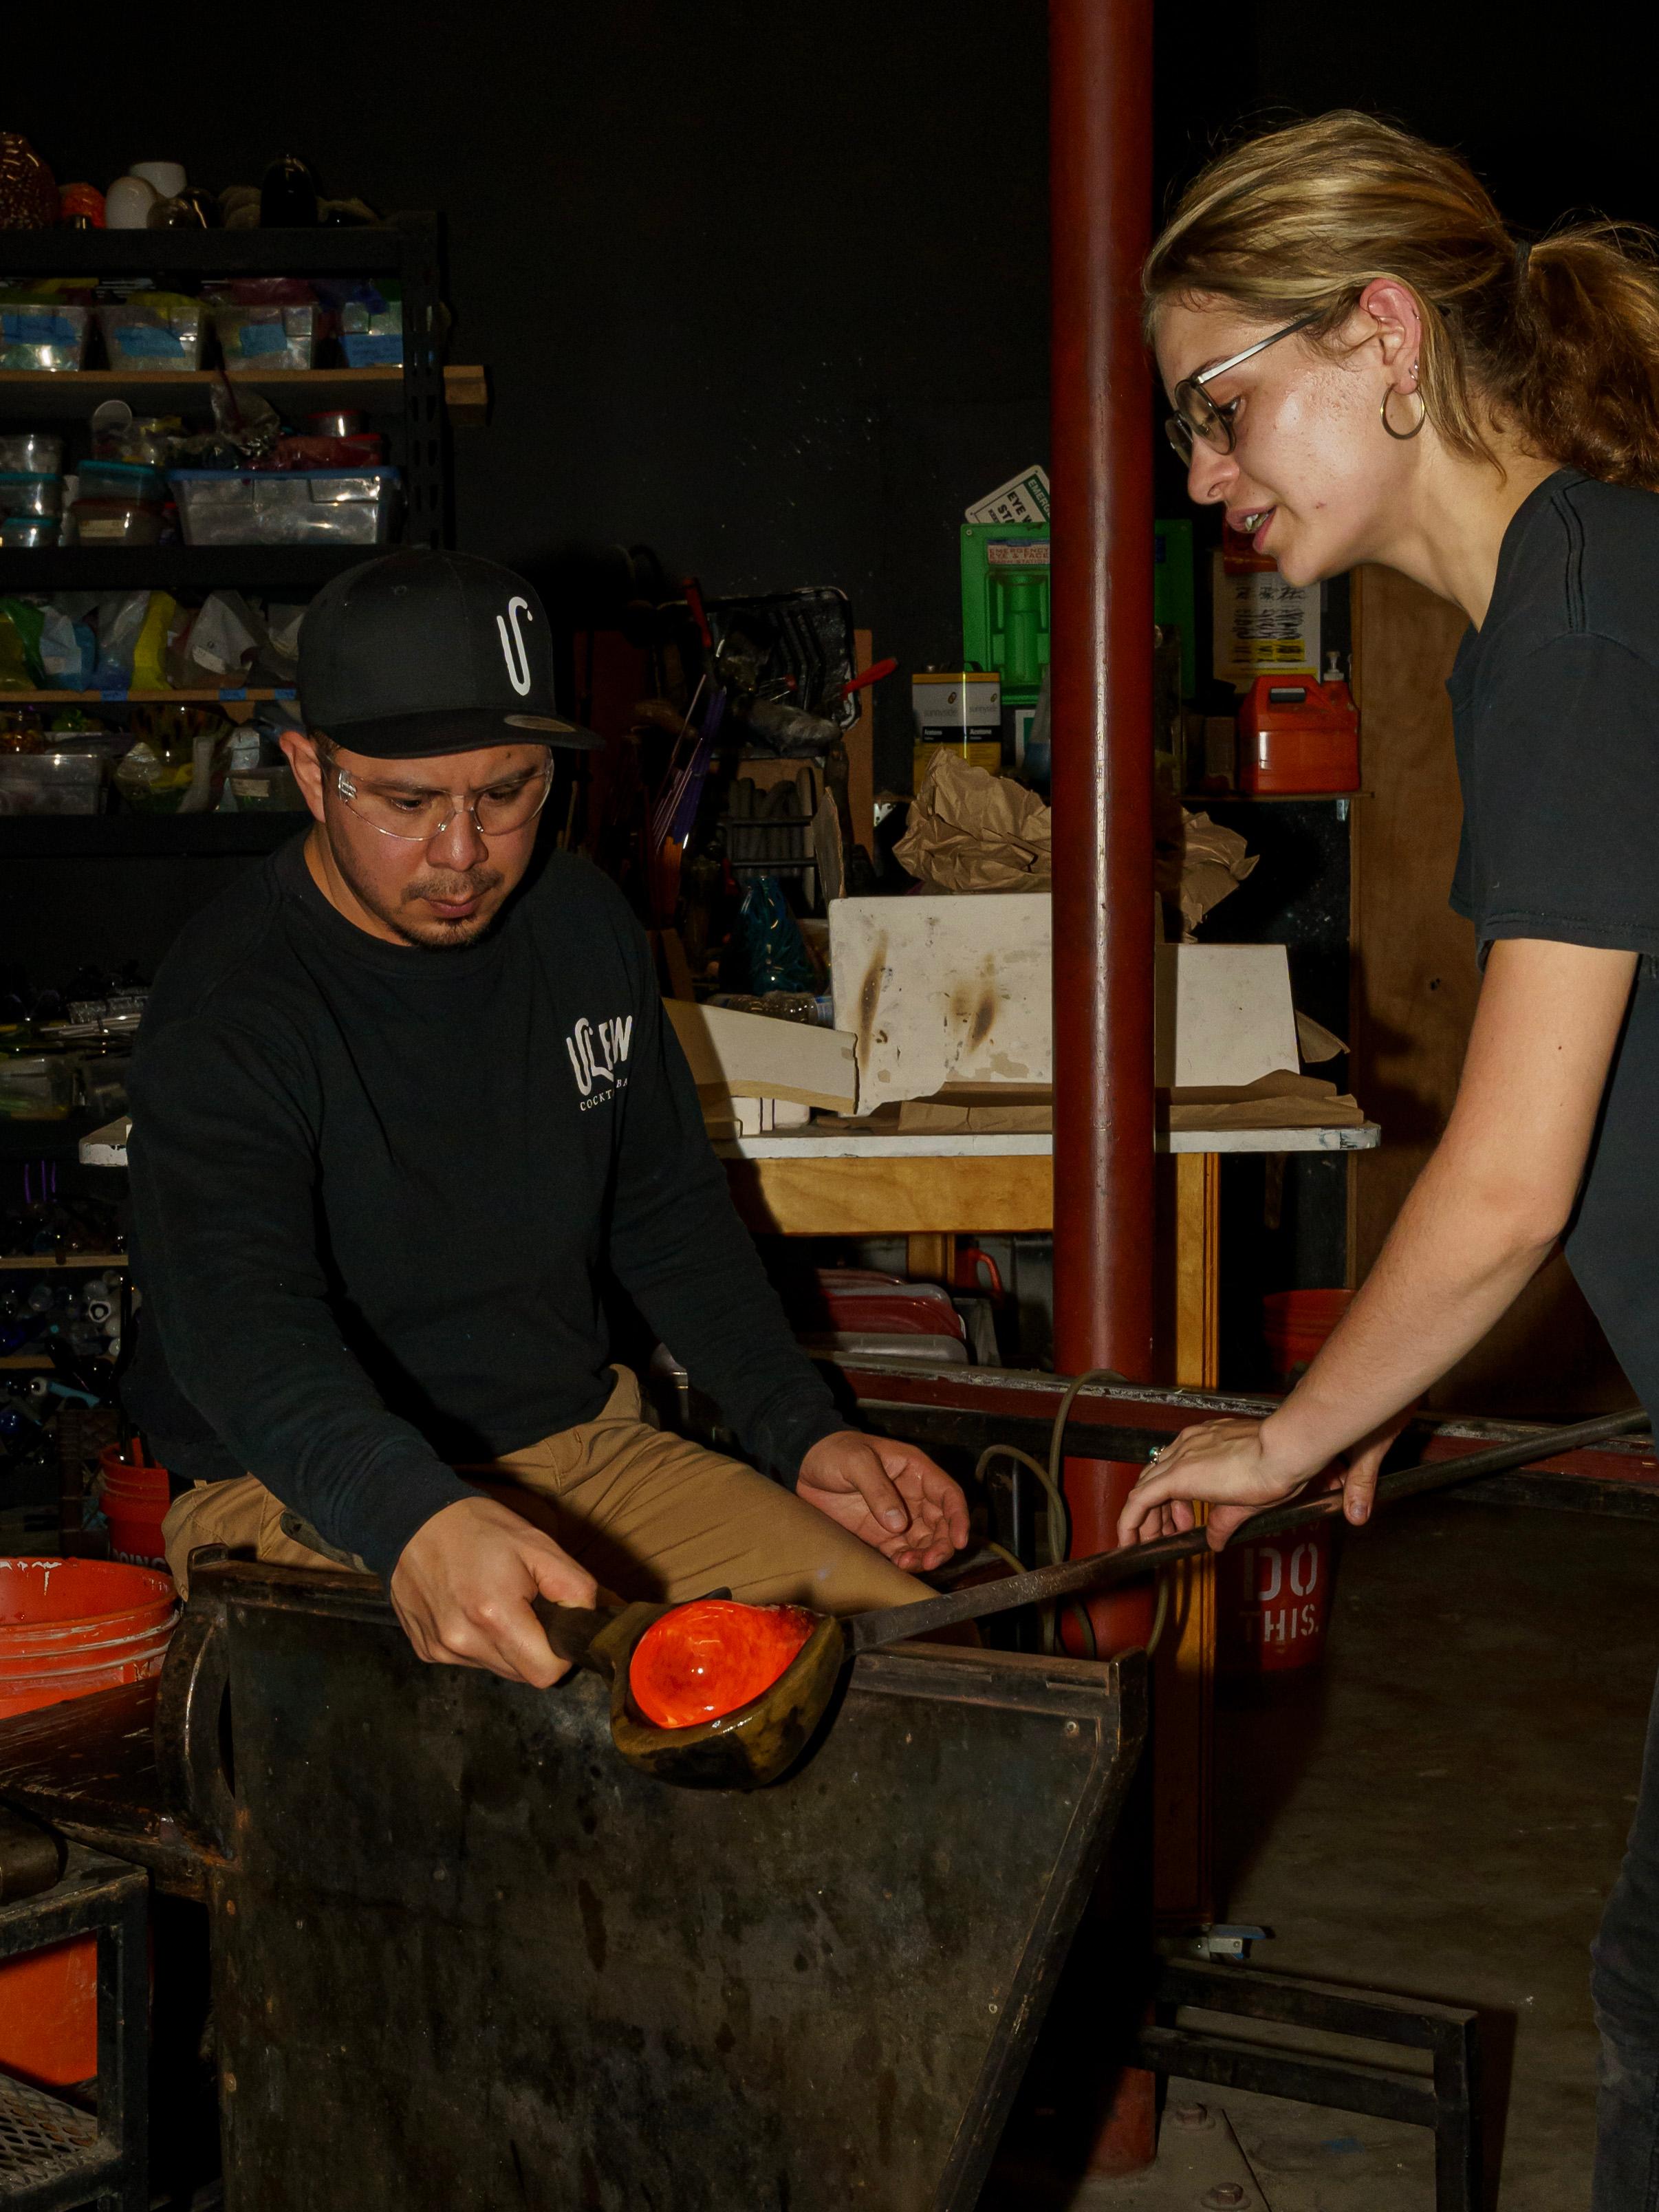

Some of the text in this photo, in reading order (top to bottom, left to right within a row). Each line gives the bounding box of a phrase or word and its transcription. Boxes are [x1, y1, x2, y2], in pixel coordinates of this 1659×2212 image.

[1007, 491, 1026, 515] EYE
[1028, 479, 1050, 517] EMERG
[579, 1089, 615, 1112] COCKT
[1243, 1542, 1319, 1601] DO
